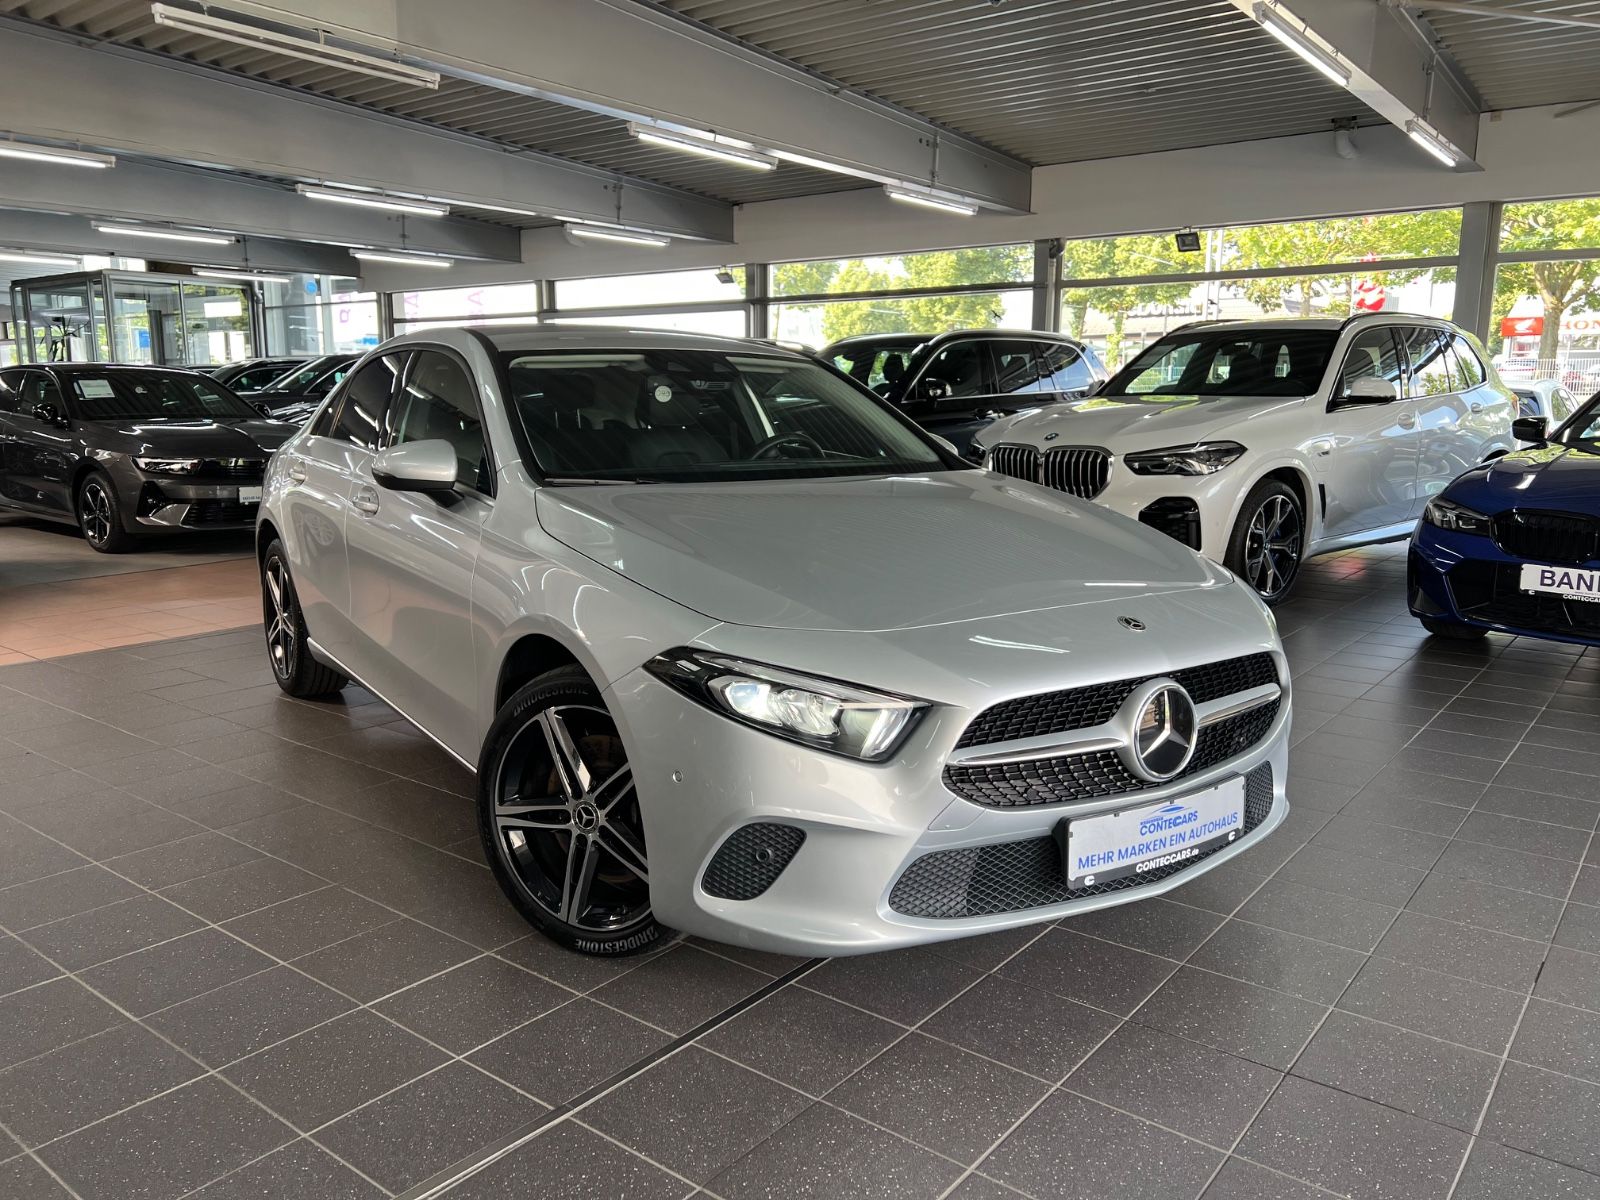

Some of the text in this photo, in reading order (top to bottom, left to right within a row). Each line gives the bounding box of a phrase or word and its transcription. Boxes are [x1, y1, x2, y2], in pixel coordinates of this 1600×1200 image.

[1540, 569, 1600, 593] BAN
[1562, 594, 1600, 603] CONTECCA
[1077, 812, 1238, 870] MEHR MARKEN EIN AUTOHAUS
[1135, 848, 1200, 873] CONTECCARS.de
[575, 925, 660, 954] BRIDGESTONE
